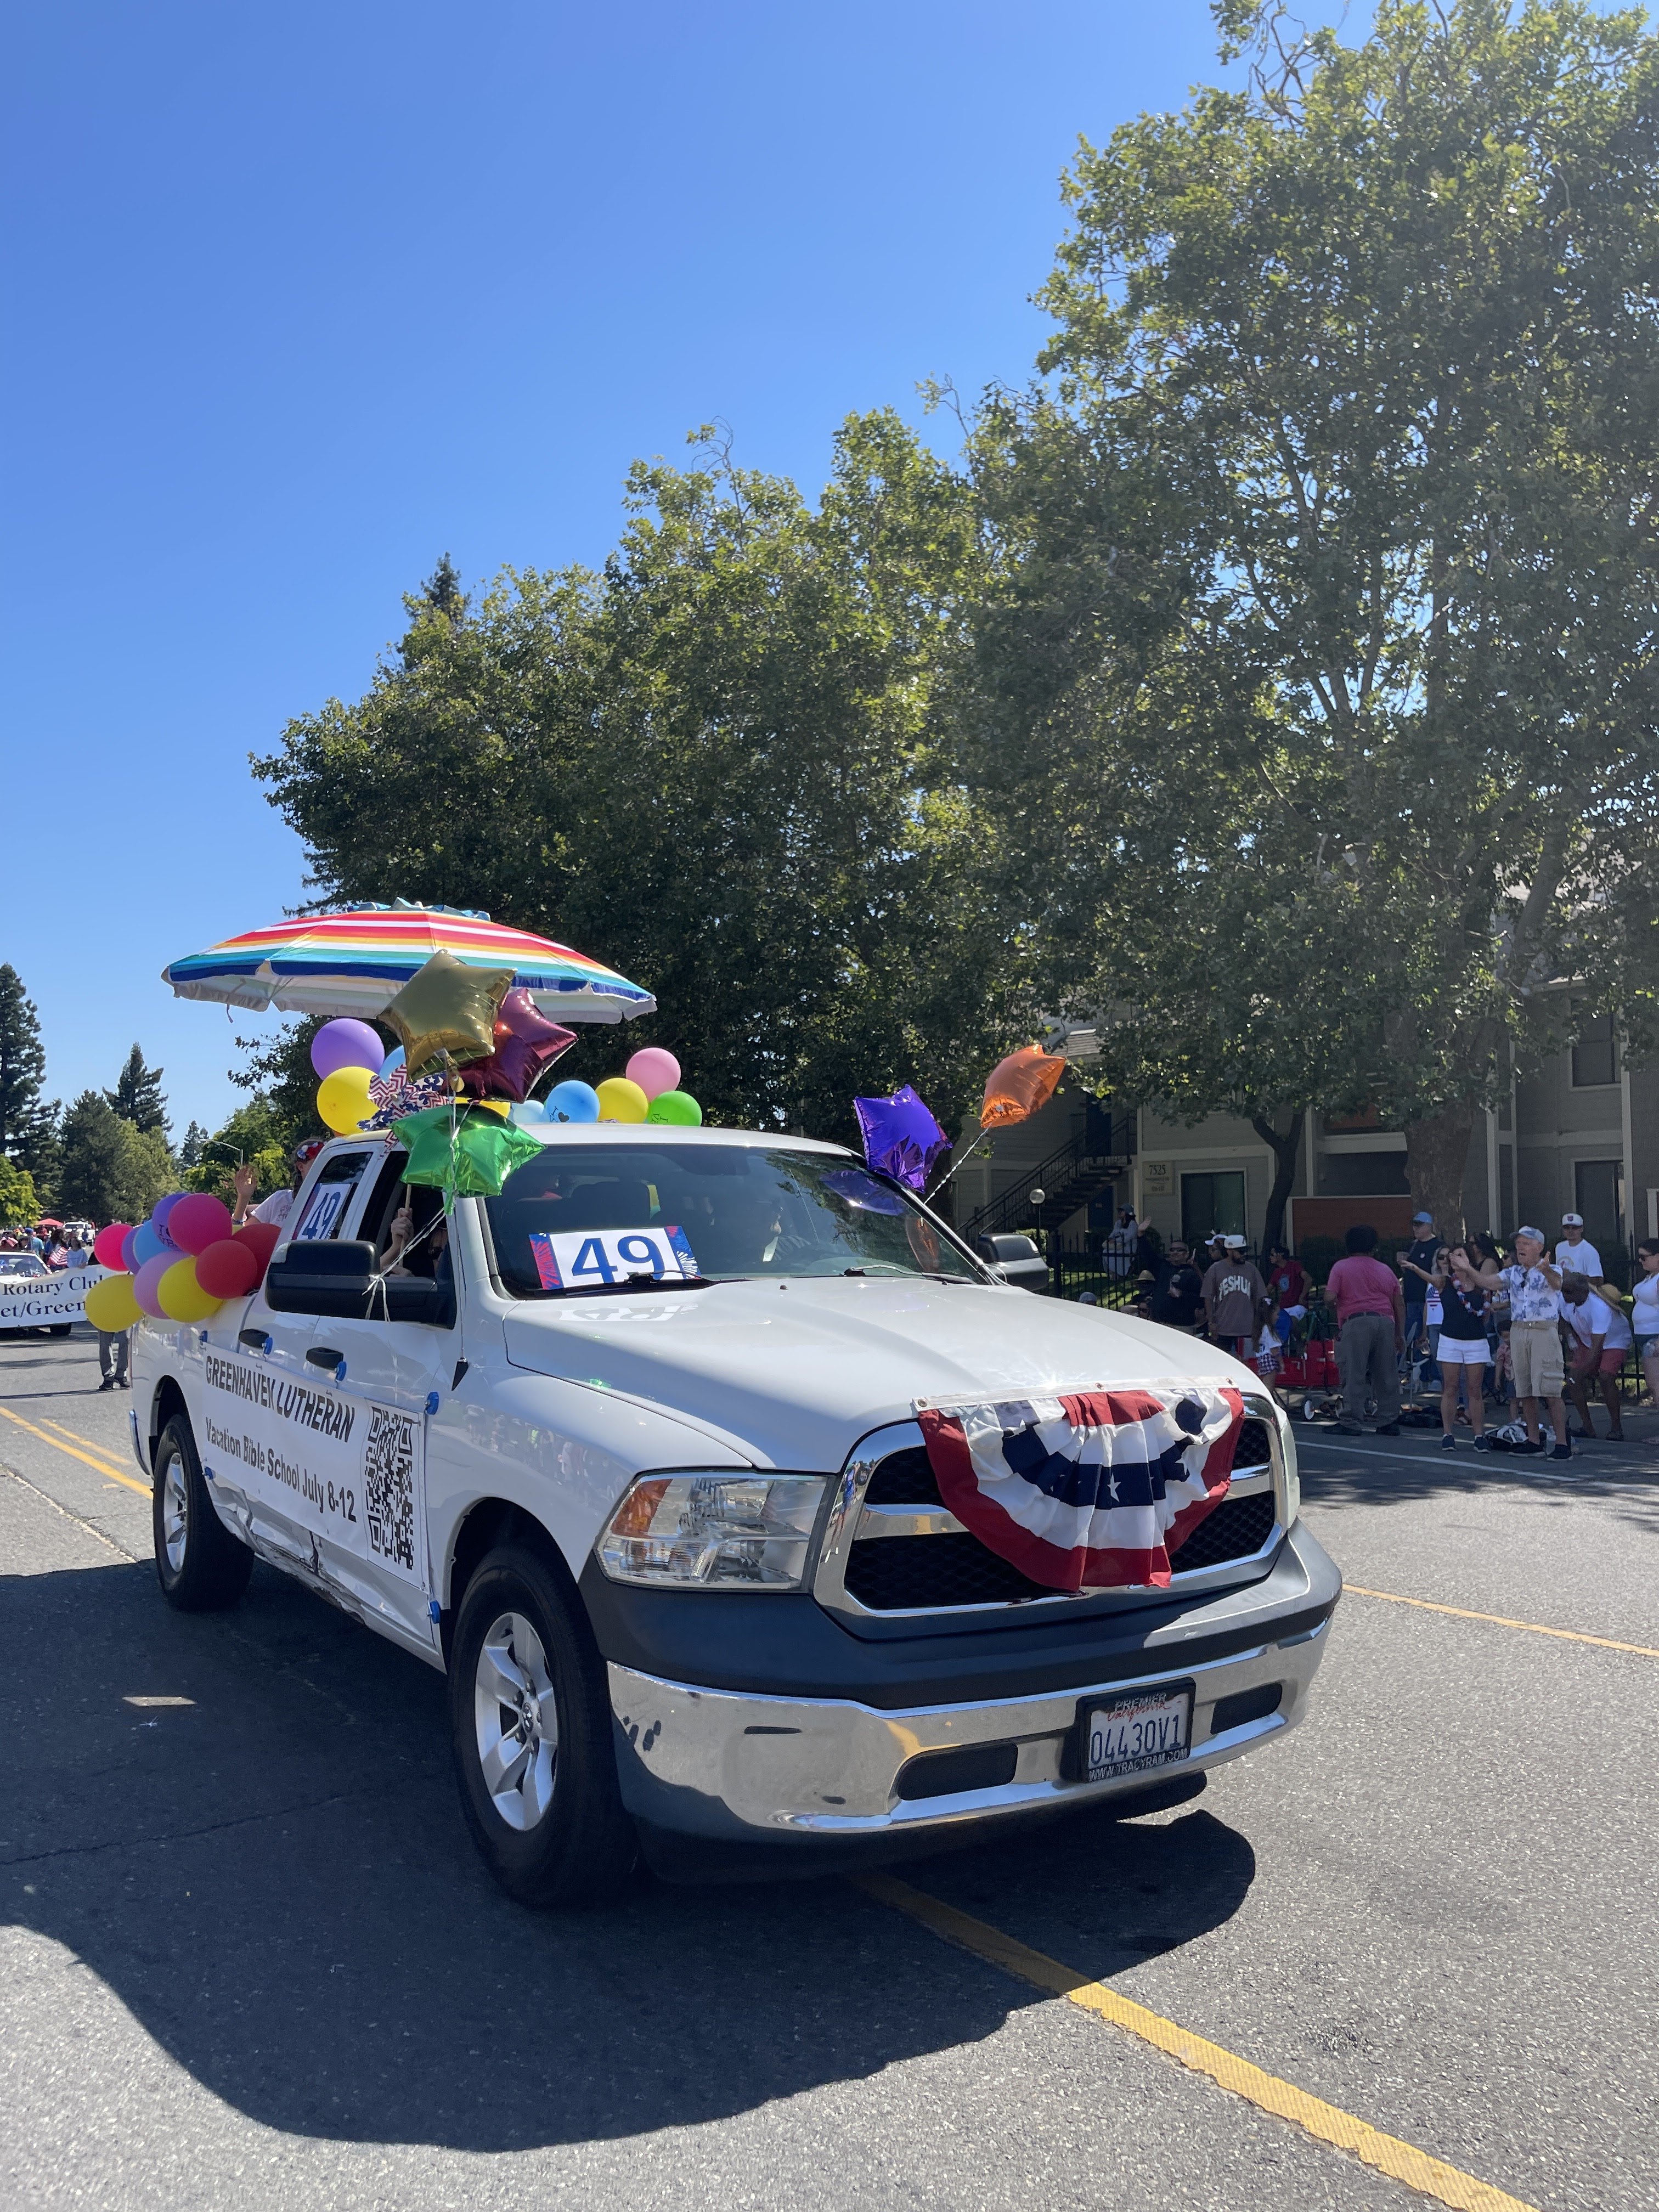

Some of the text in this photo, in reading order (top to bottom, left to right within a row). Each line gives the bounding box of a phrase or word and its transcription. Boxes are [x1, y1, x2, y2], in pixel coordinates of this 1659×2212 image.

[301, 1192, 341, 1240] 49
[571, 1235, 665, 1284] 49
[2, 1283, 64, 1296] Rotary
[205, 1355, 356, 1443] GREENHAVEN LUTHERAN
[205, 1417, 357, 1523] Vacation Bible School July 8-12
[1107, 1701, 1172, 1723] California
[1114, 1692, 1167, 1712] PREMIER
[1090, 1714, 1182, 1765] 04430V1
